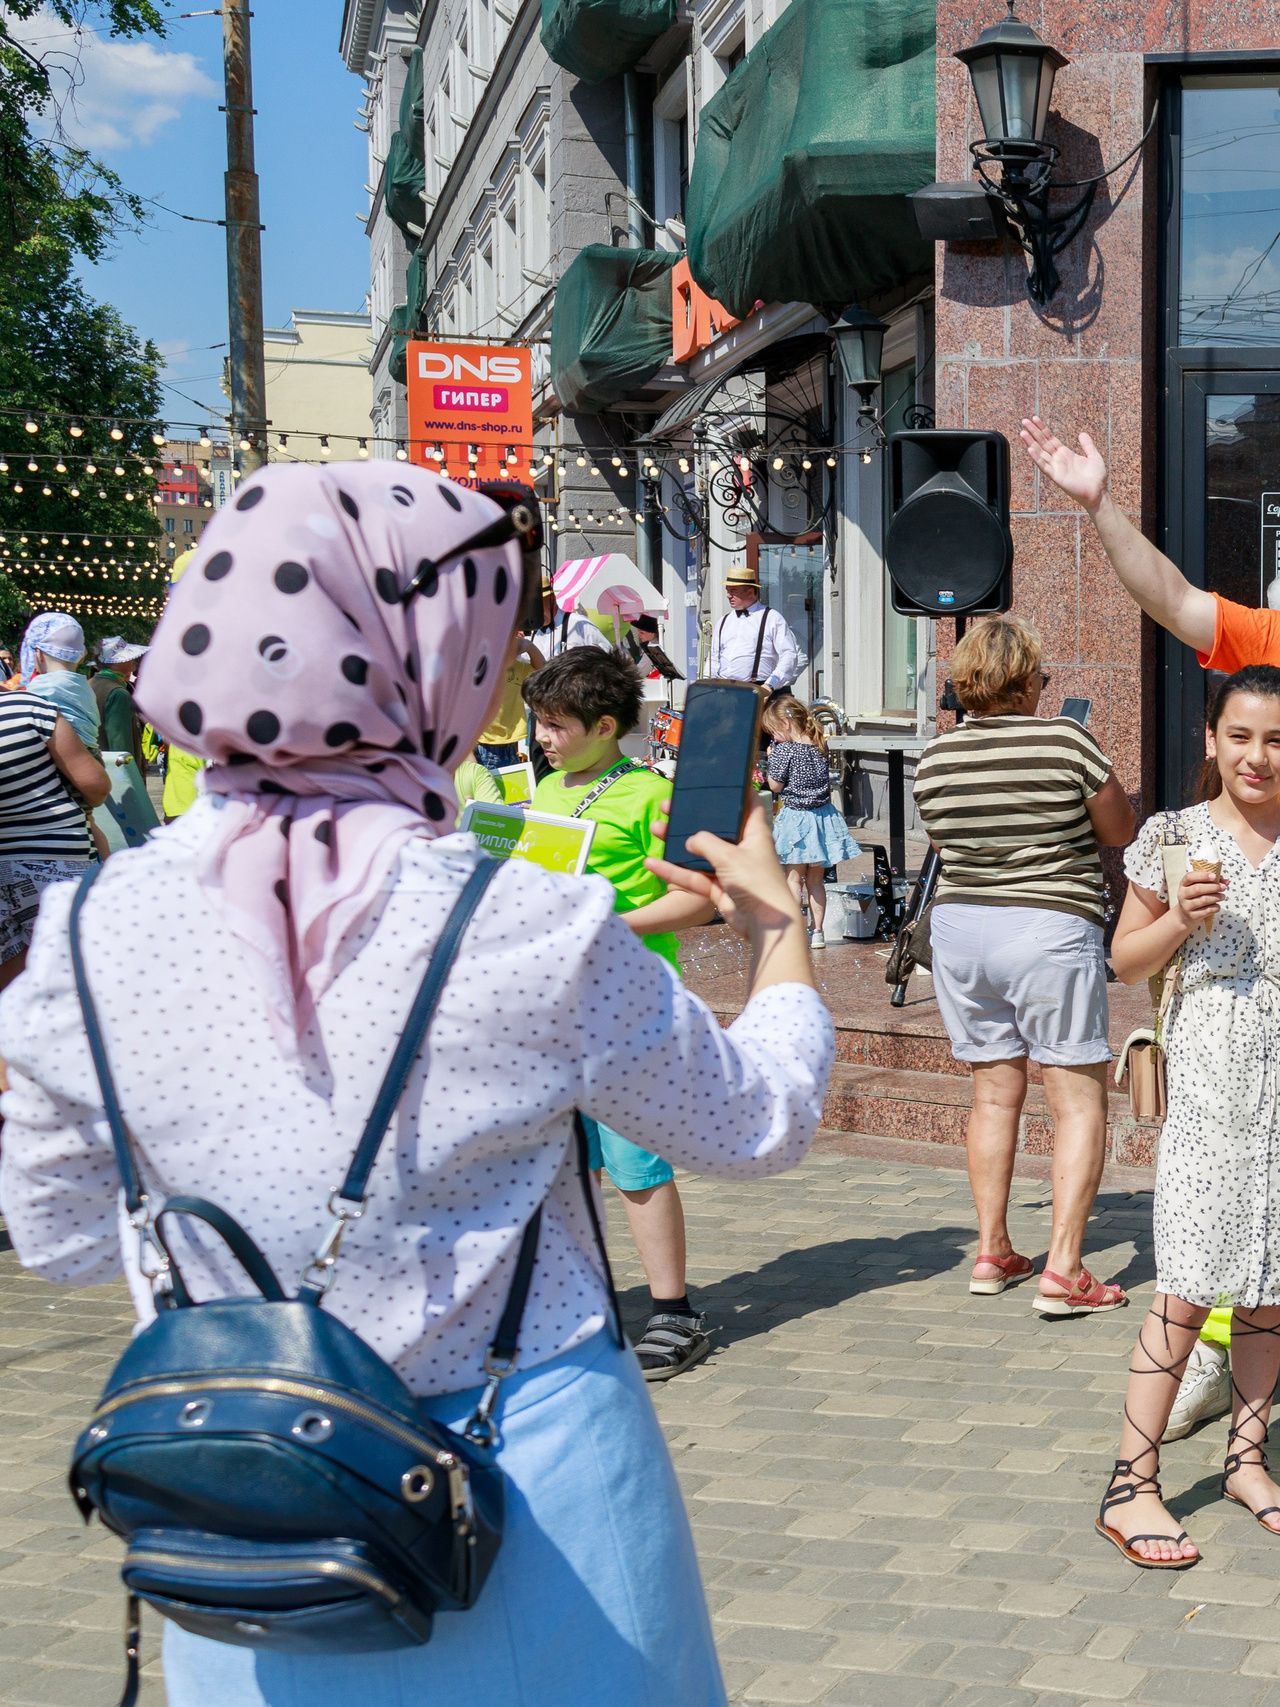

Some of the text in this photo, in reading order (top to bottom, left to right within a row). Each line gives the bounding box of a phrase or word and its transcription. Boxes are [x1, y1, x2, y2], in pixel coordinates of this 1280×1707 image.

[418, 352, 522, 383] DNS
[441, 390, 502, 407] ГИПЕР
[424, 421, 523, 434] www.dns-shop.ru
